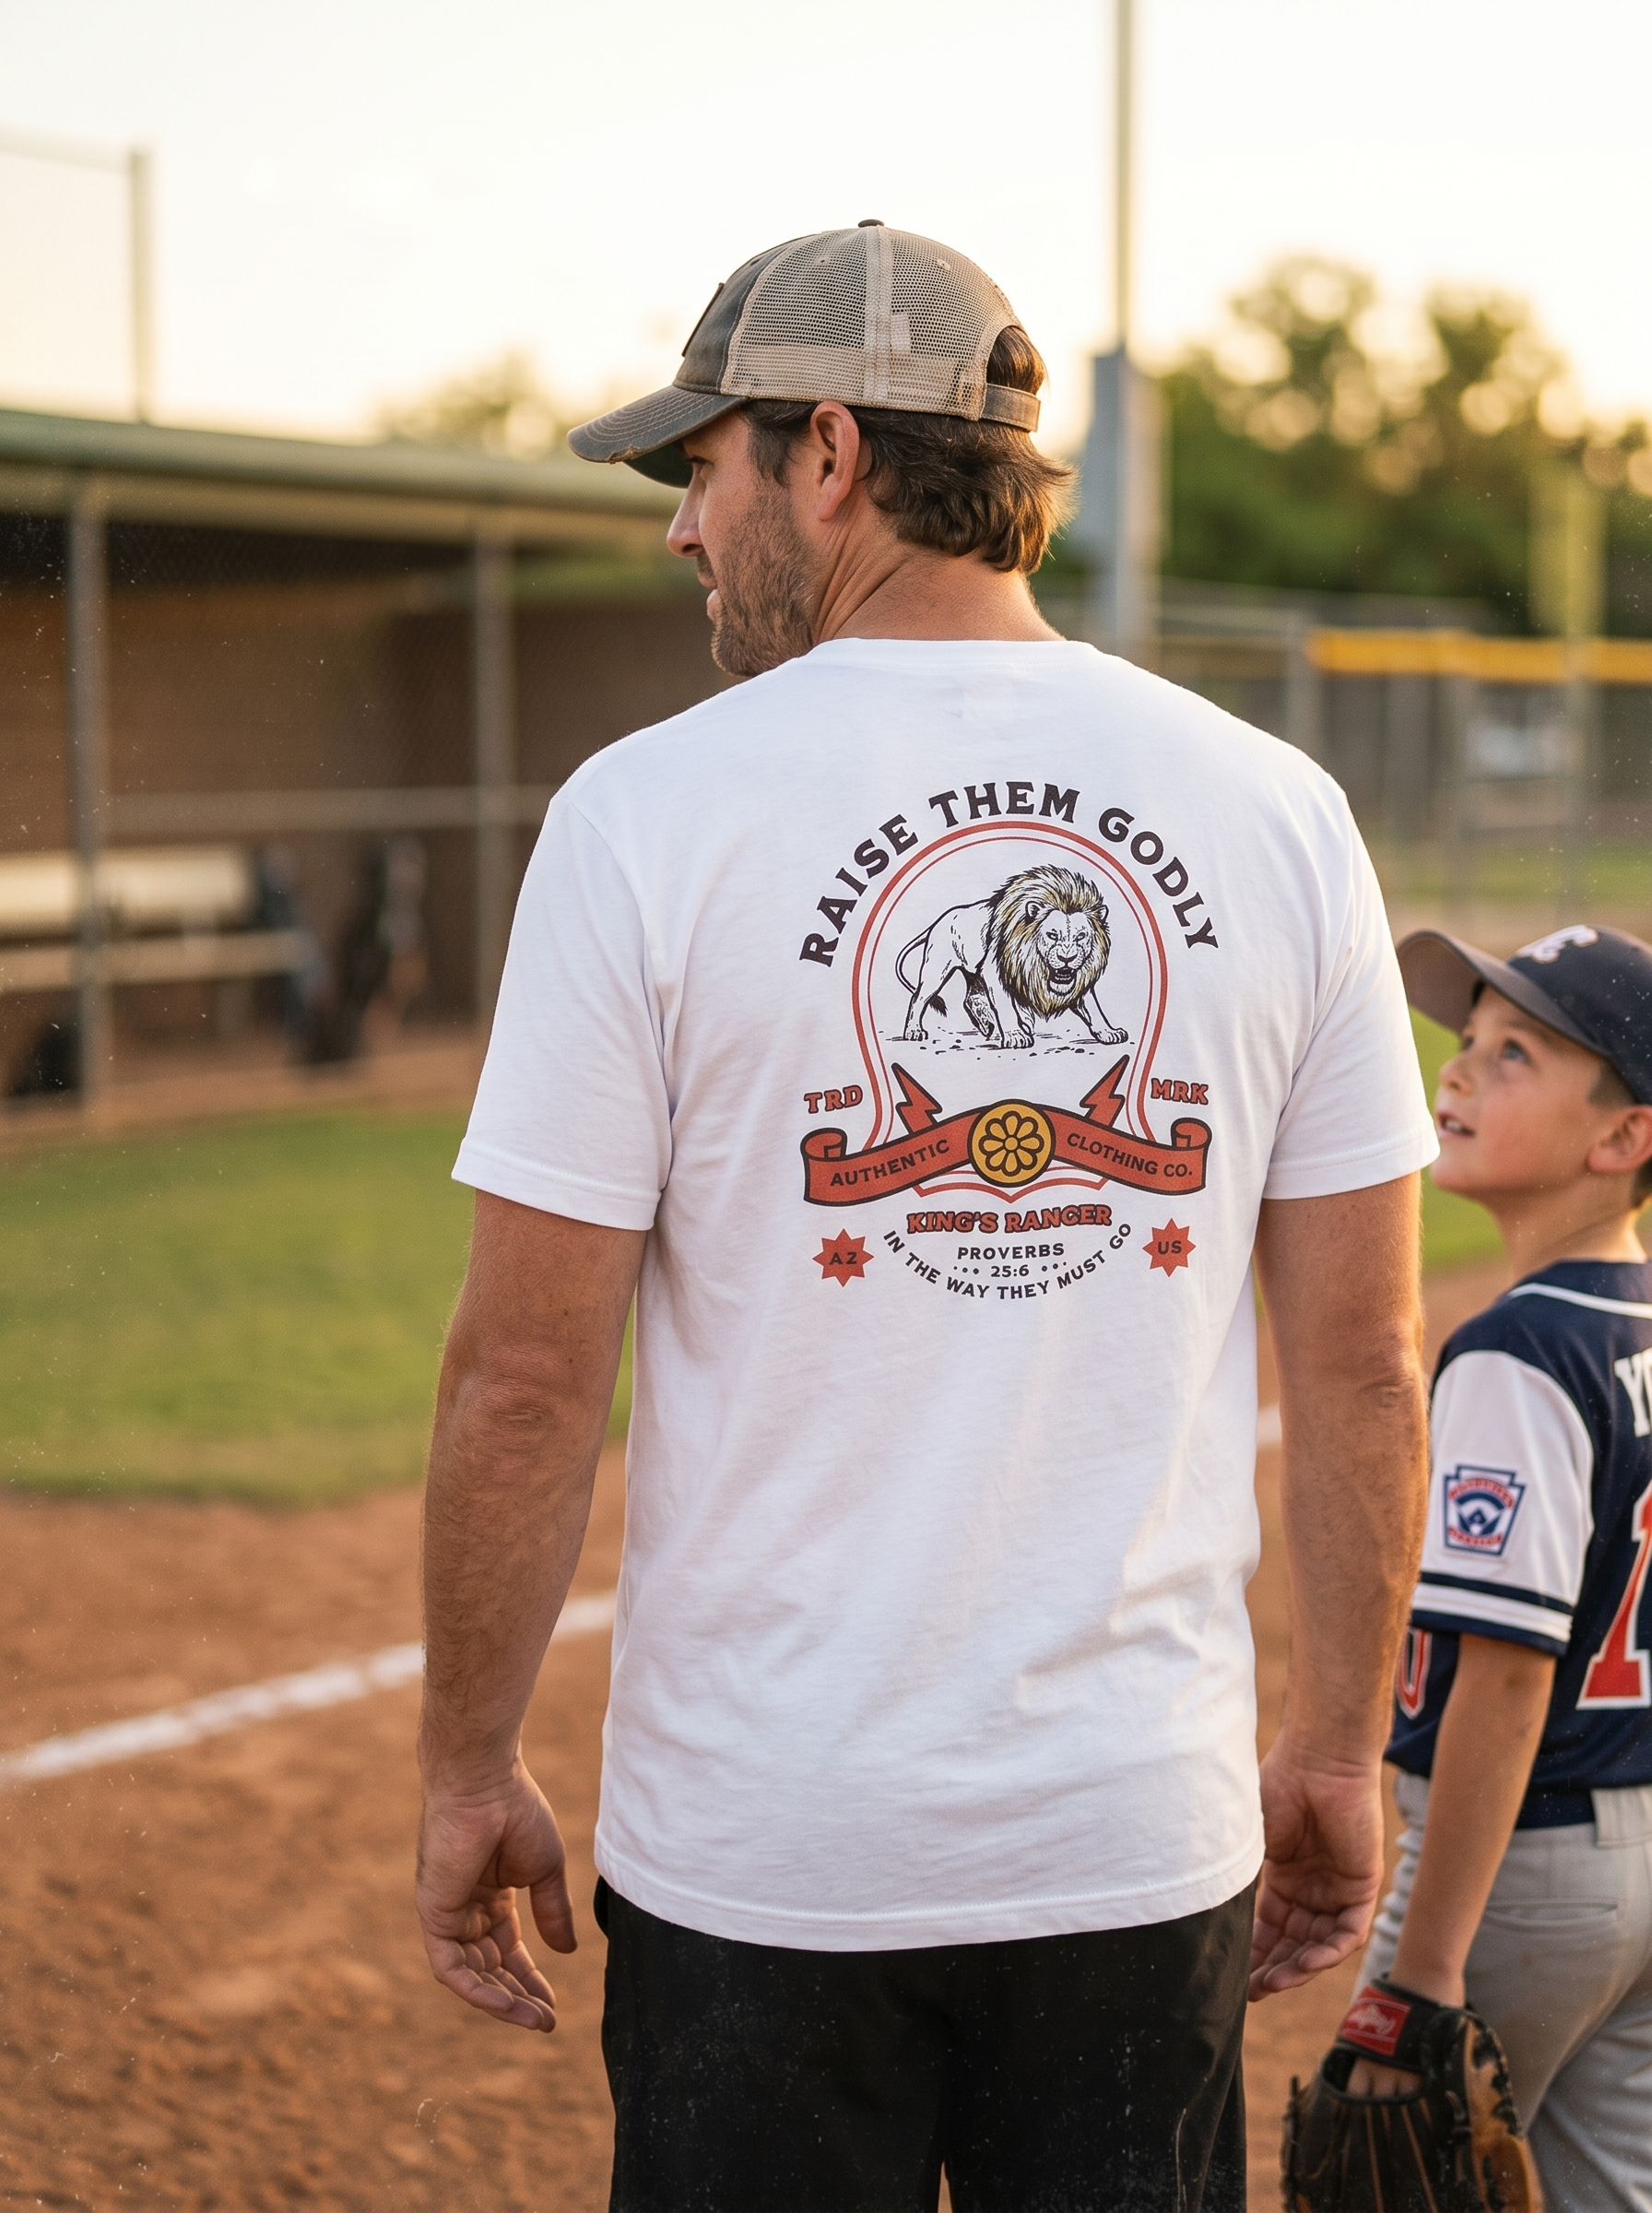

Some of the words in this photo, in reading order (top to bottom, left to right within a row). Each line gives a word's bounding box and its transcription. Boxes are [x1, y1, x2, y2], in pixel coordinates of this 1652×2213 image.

[799, 813, 919, 968] RAISE
[927, 781, 1080, 828] THEM
[1098, 807, 1219, 950] GODLY
[803, 1084, 864, 1114] TRD
[1150, 1078, 1210, 1106] MRK
[830, 1139, 950, 1187] AUTHENTIC
[1067, 1132, 1159, 1176] CLOTHING
[1162, 1163, 1193, 1178] CO.
[906, 1211, 999, 1235] KING'S
[957, 1243, 1065, 1260] PROVERBS
[1157, 1239, 1182, 1255] US
[883, 1230, 906, 1253] IN
[904, 1252, 941, 1284] THE
[946, 1276, 990, 1299] WAY
[996, 1280, 1050, 1300] THEY
[1057, 1249, 1105, 1290] MUST
[1109, 1223, 1131, 1249] GO
[990, 1264, 1030, 1278] 25:6
